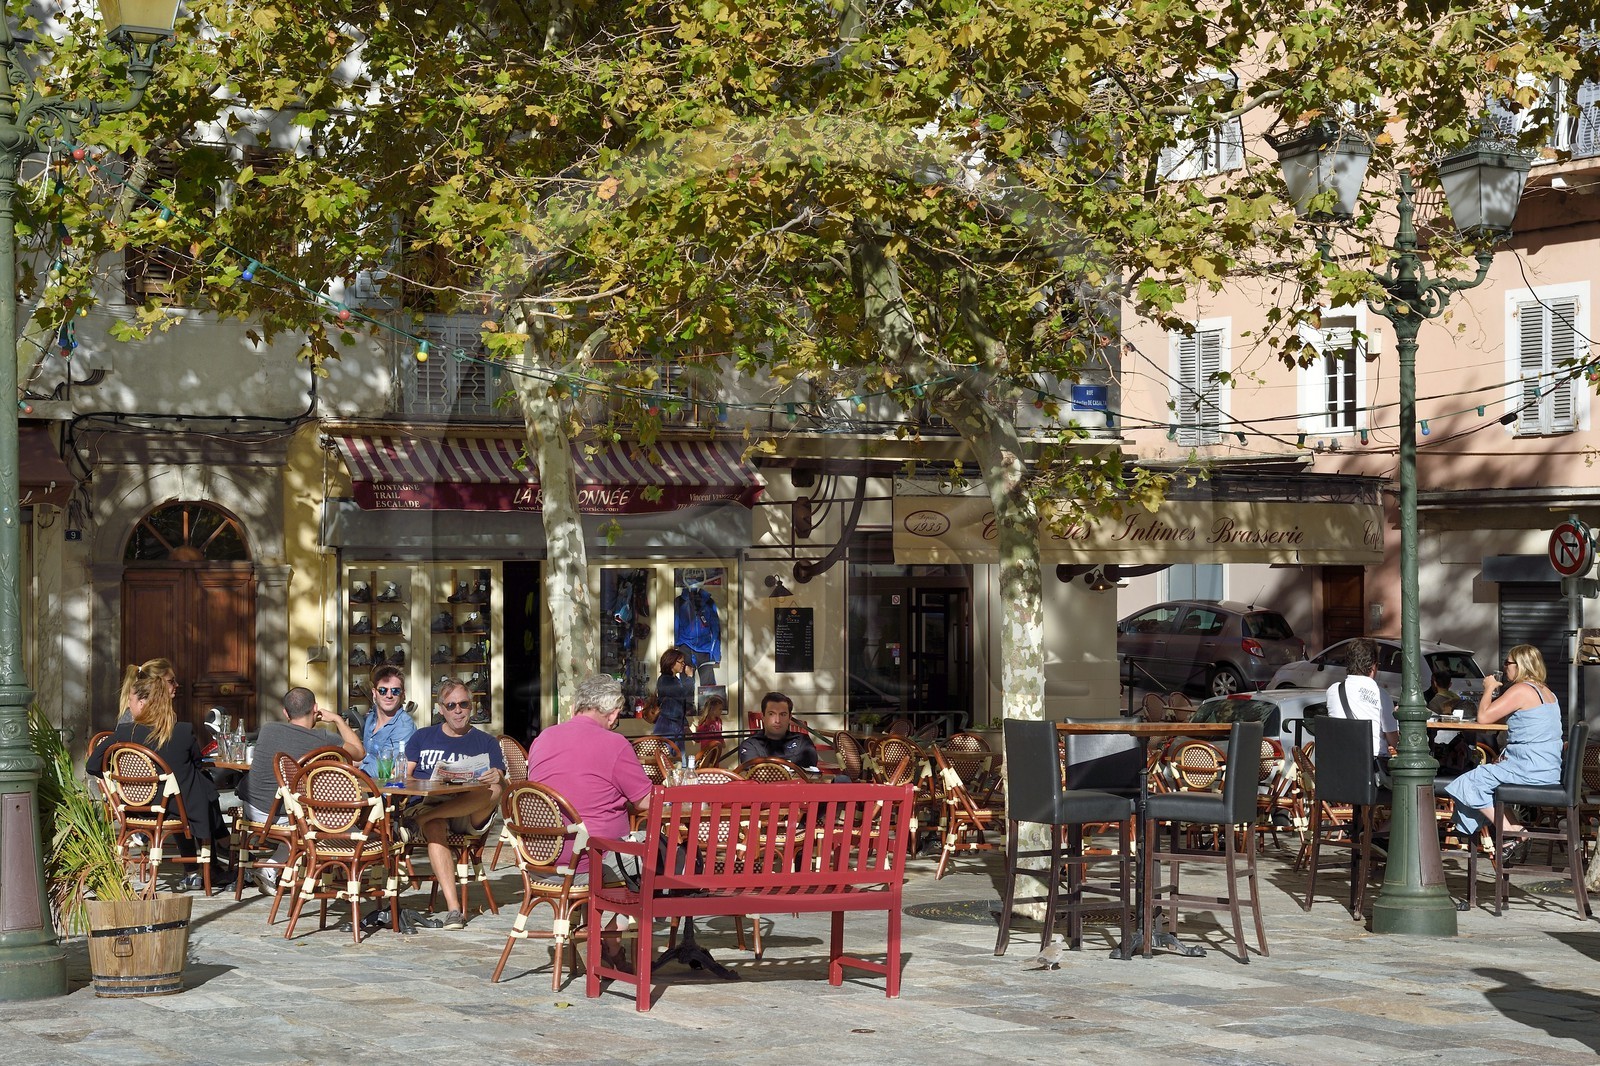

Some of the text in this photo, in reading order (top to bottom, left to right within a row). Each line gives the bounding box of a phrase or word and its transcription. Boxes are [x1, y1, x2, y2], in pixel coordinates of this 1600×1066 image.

[372, 483, 420, 491] MONTAGNE
[373, 491, 401, 499] TRAIL
[689, 493, 711, 501] Vincent
[375, 500, 421, 508] ESCALADE
[912, 522, 943, 532] 1935
[1111, 513, 1197, 542] Intimes
[1206, 516, 1304, 544] Brasserie
